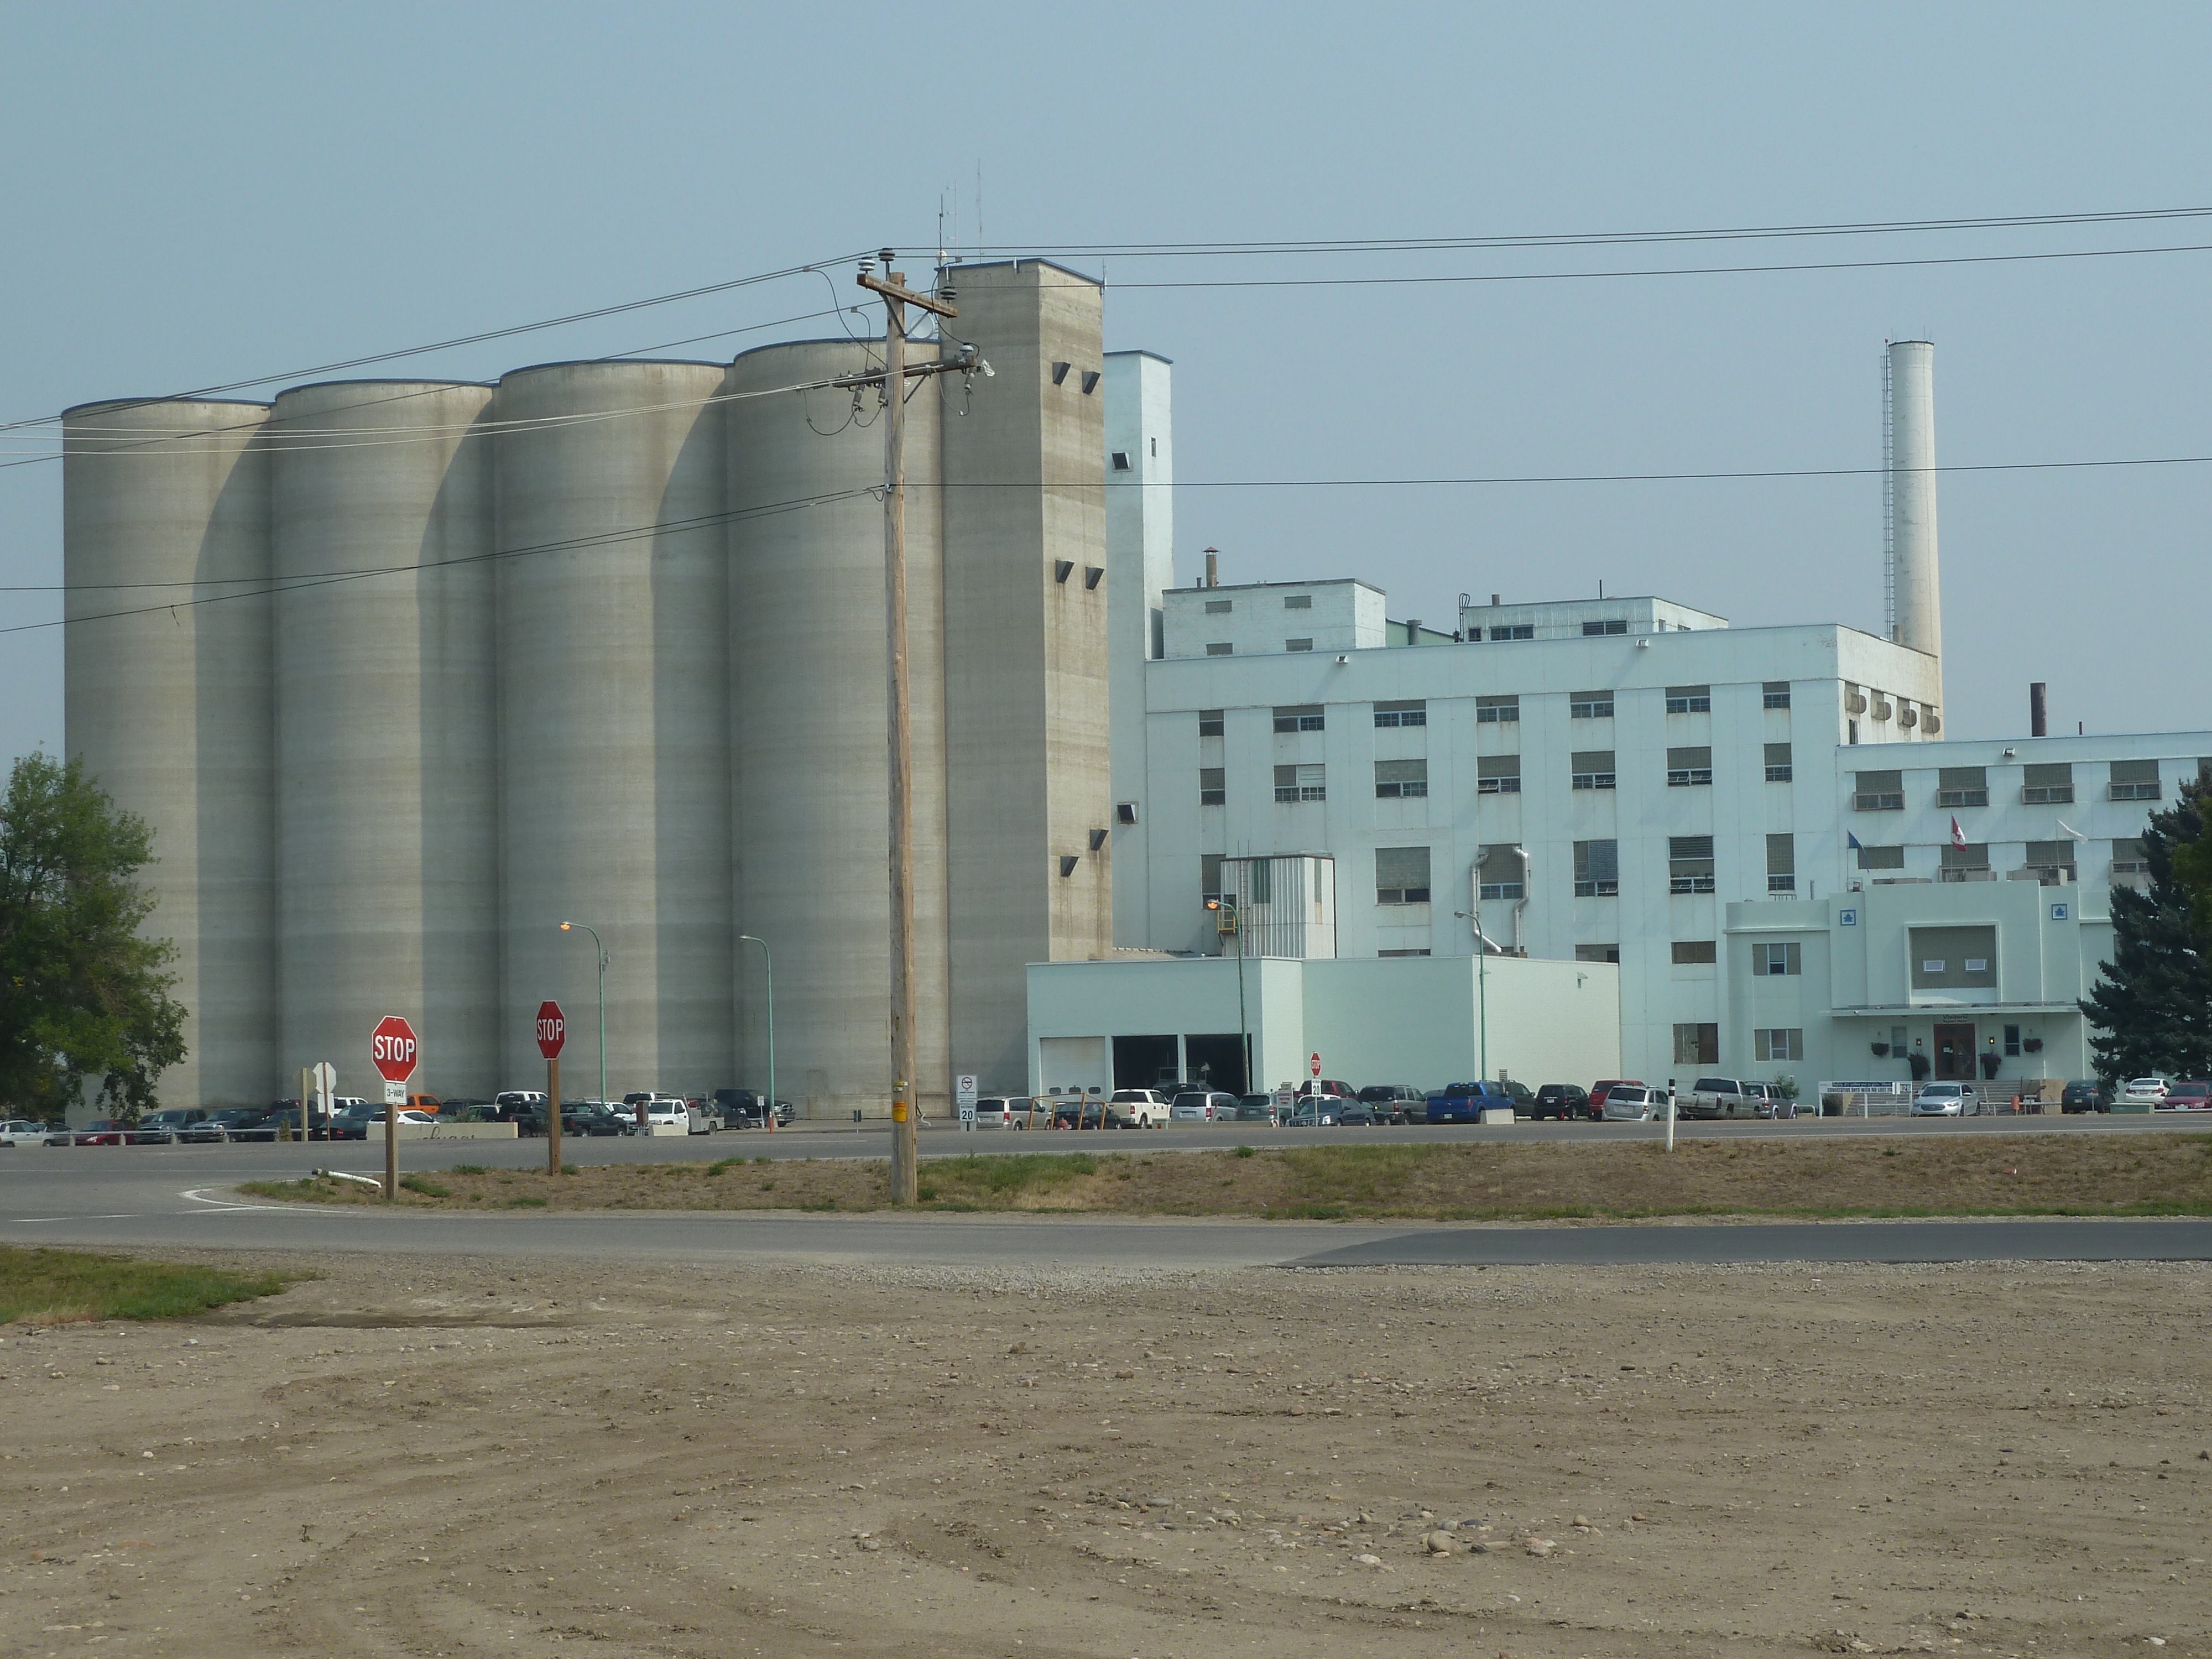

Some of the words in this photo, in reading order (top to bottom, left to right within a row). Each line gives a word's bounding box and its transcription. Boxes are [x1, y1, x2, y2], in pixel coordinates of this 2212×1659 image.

[537, 1019, 564, 1040] STOP
[374, 1035, 415, 1062] STOP
[1311, 1060, 1321, 1070] STOP
[387, 1088, 405, 1098] 3-WAY
[1313, 1085, 1320, 1095] 20
[962, 1110, 973, 1120] 20
